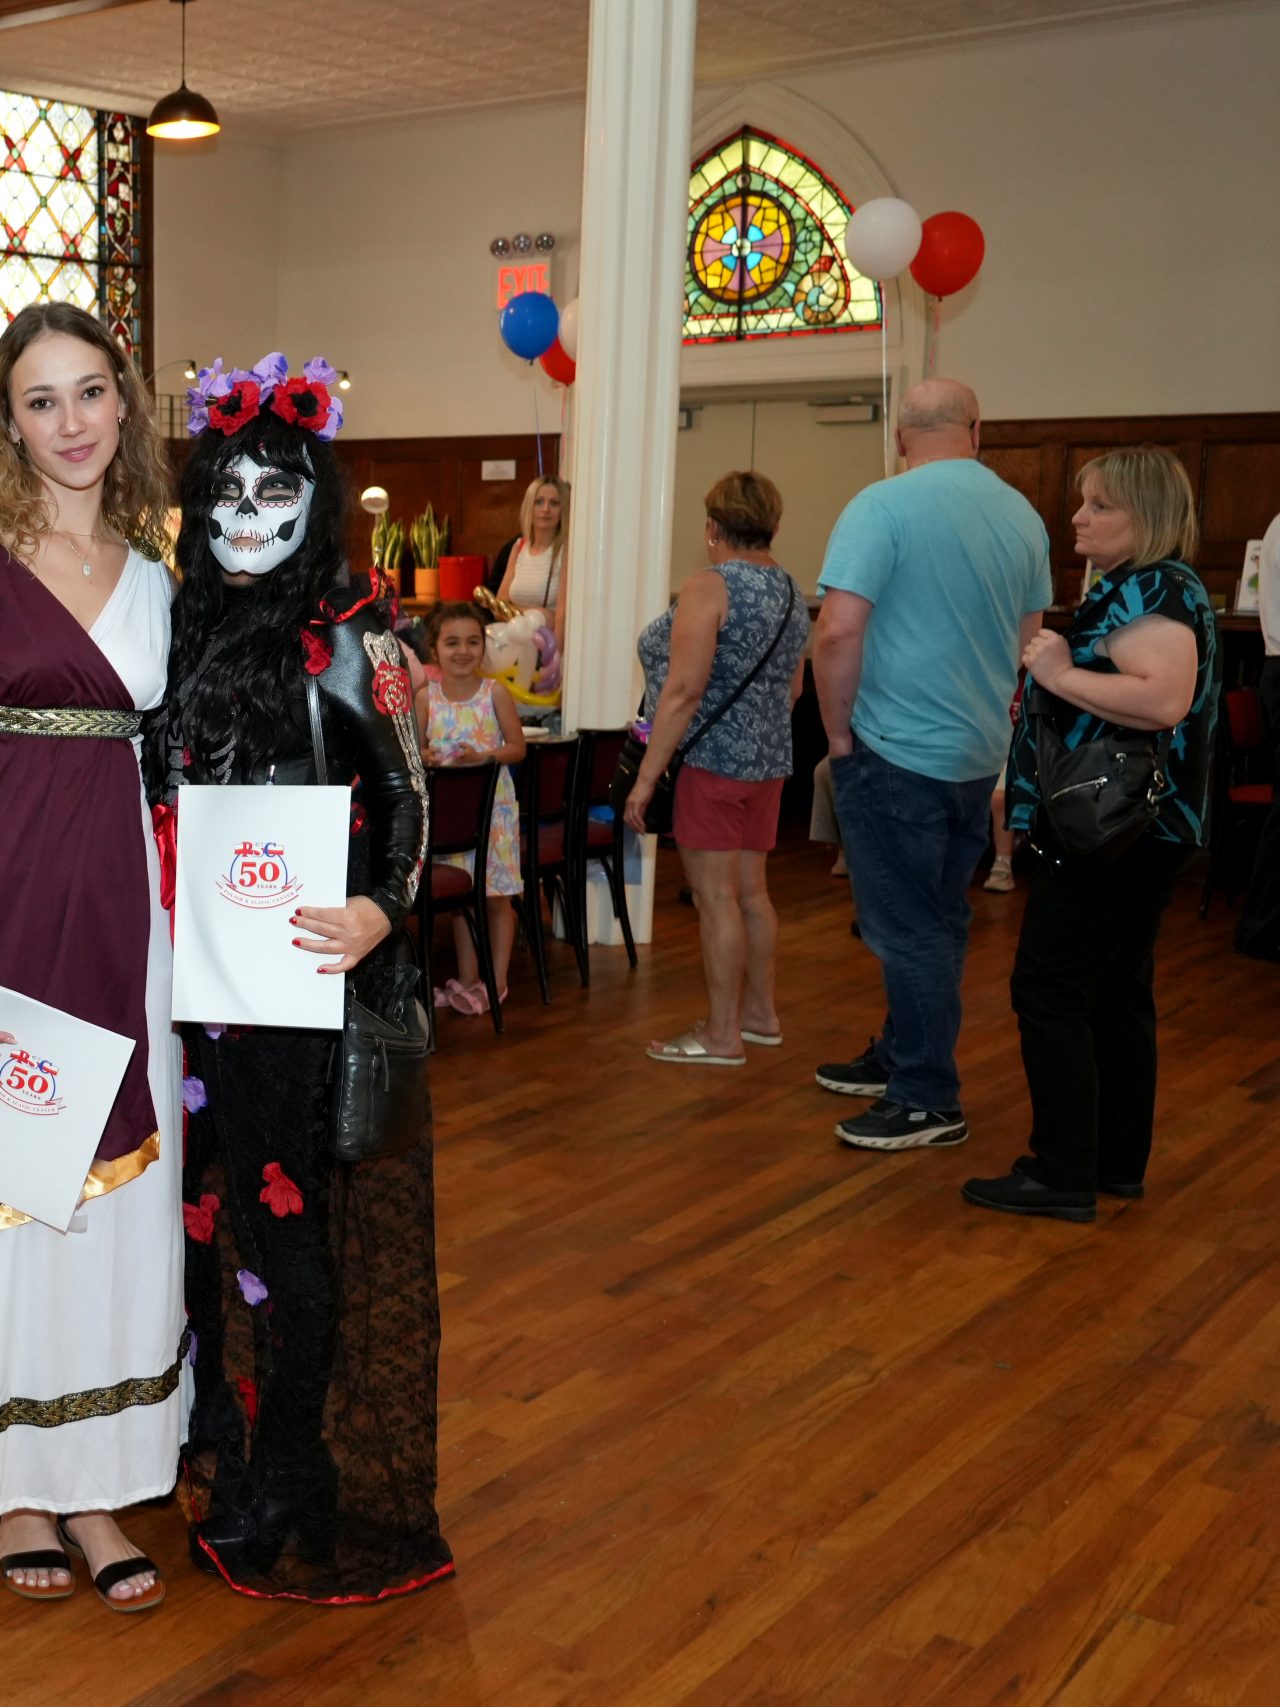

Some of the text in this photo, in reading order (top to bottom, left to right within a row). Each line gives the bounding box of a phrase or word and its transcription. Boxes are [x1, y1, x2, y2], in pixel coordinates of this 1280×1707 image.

[498, 264, 547, 308] EXIT
[238, 861, 280, 887] 50
[6, 1066, 49, 1094] 50
